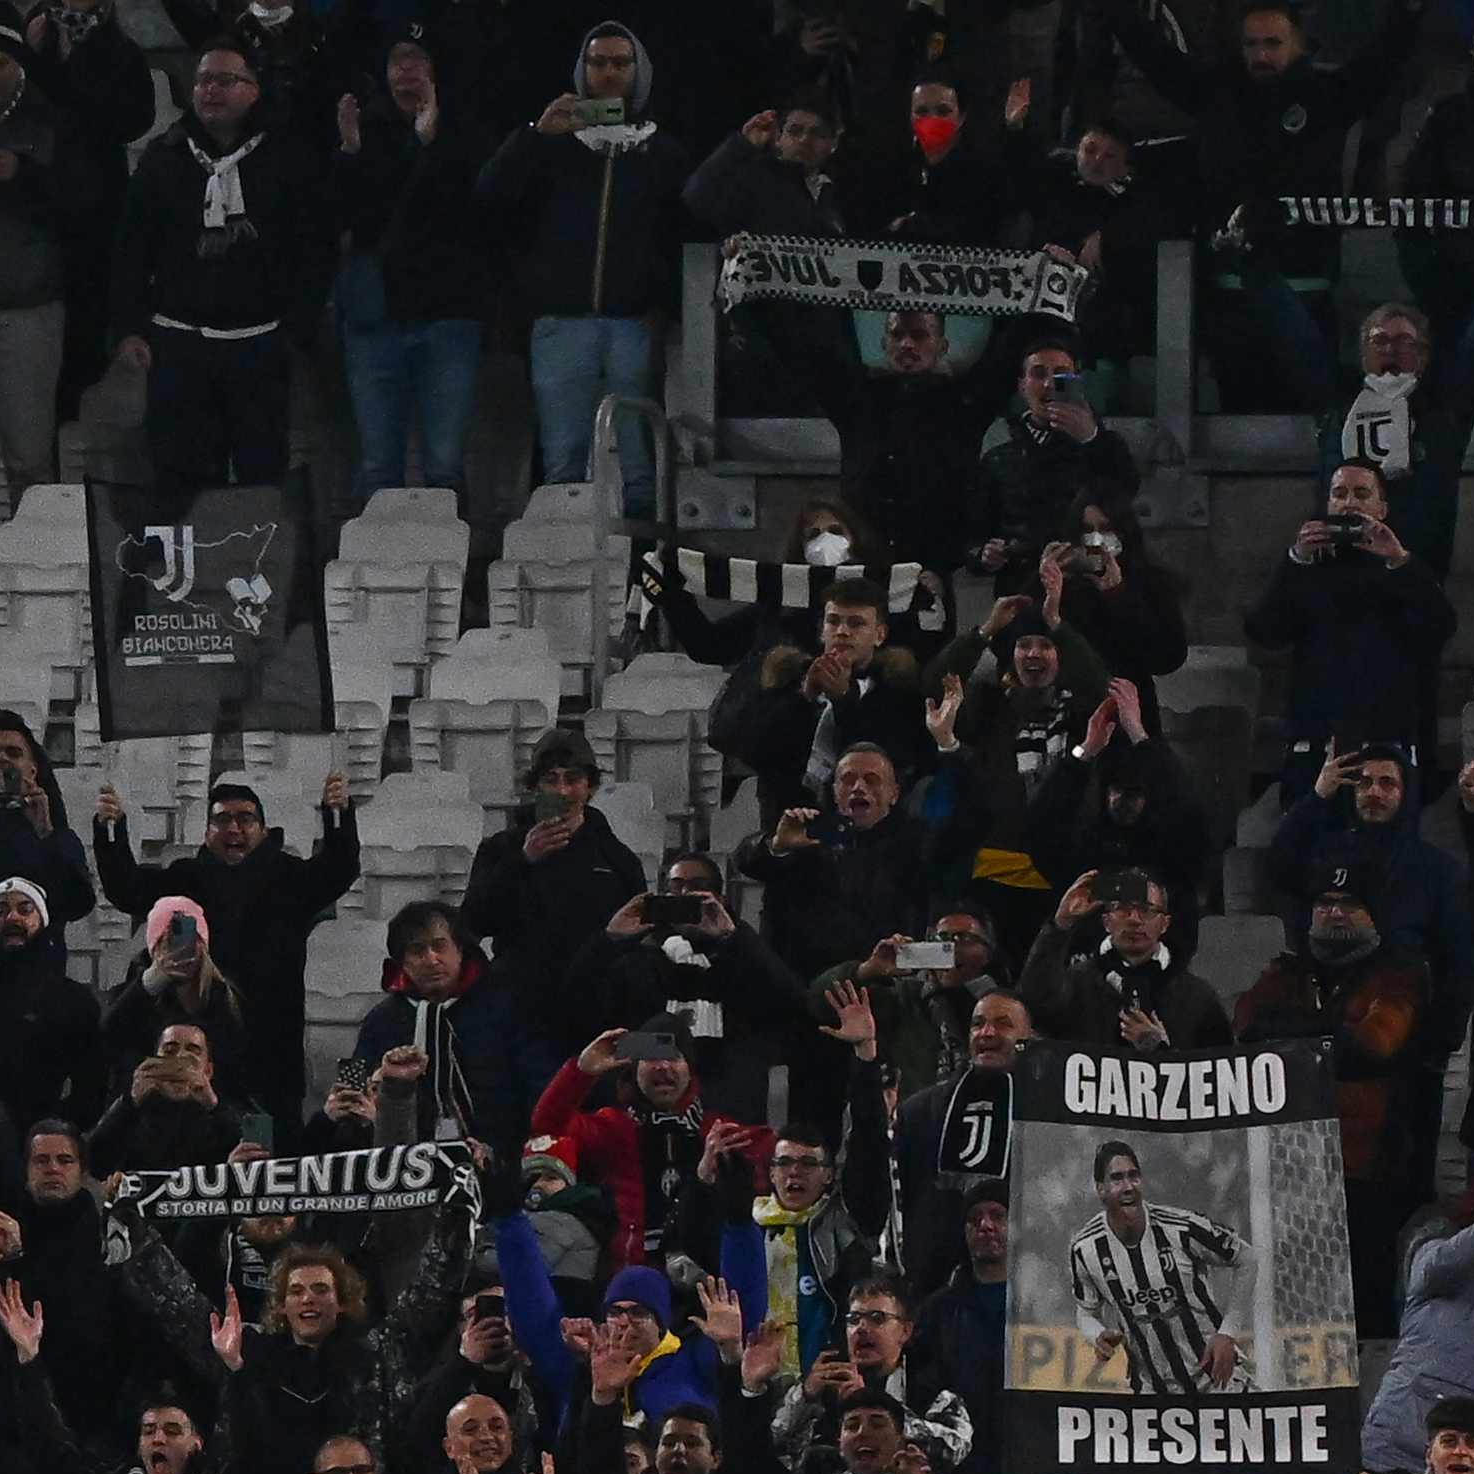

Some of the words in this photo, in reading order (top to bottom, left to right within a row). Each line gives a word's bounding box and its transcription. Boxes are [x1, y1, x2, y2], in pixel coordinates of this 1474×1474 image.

[134, 613, 218, 632] ROSOLINI
[122, 634, 234, 654] BIANCONERA
[1063, 1051, 1287, 1121] GARZENO
[165, 1142, 439, 1200] JUVENTUS
[156, 1199, 228, 1218] STORIA
[232, 1199, 253, 1215] DI
[257, 1198, 286, 1214] UN
[291, 1194, 369, 1213] GRANDE
[373, 1188, 439, 1211] AMORE
[1126, 1282, 1177, 1307] Jeep
[1058, 1403, 1329, 1464] PRESENTE
